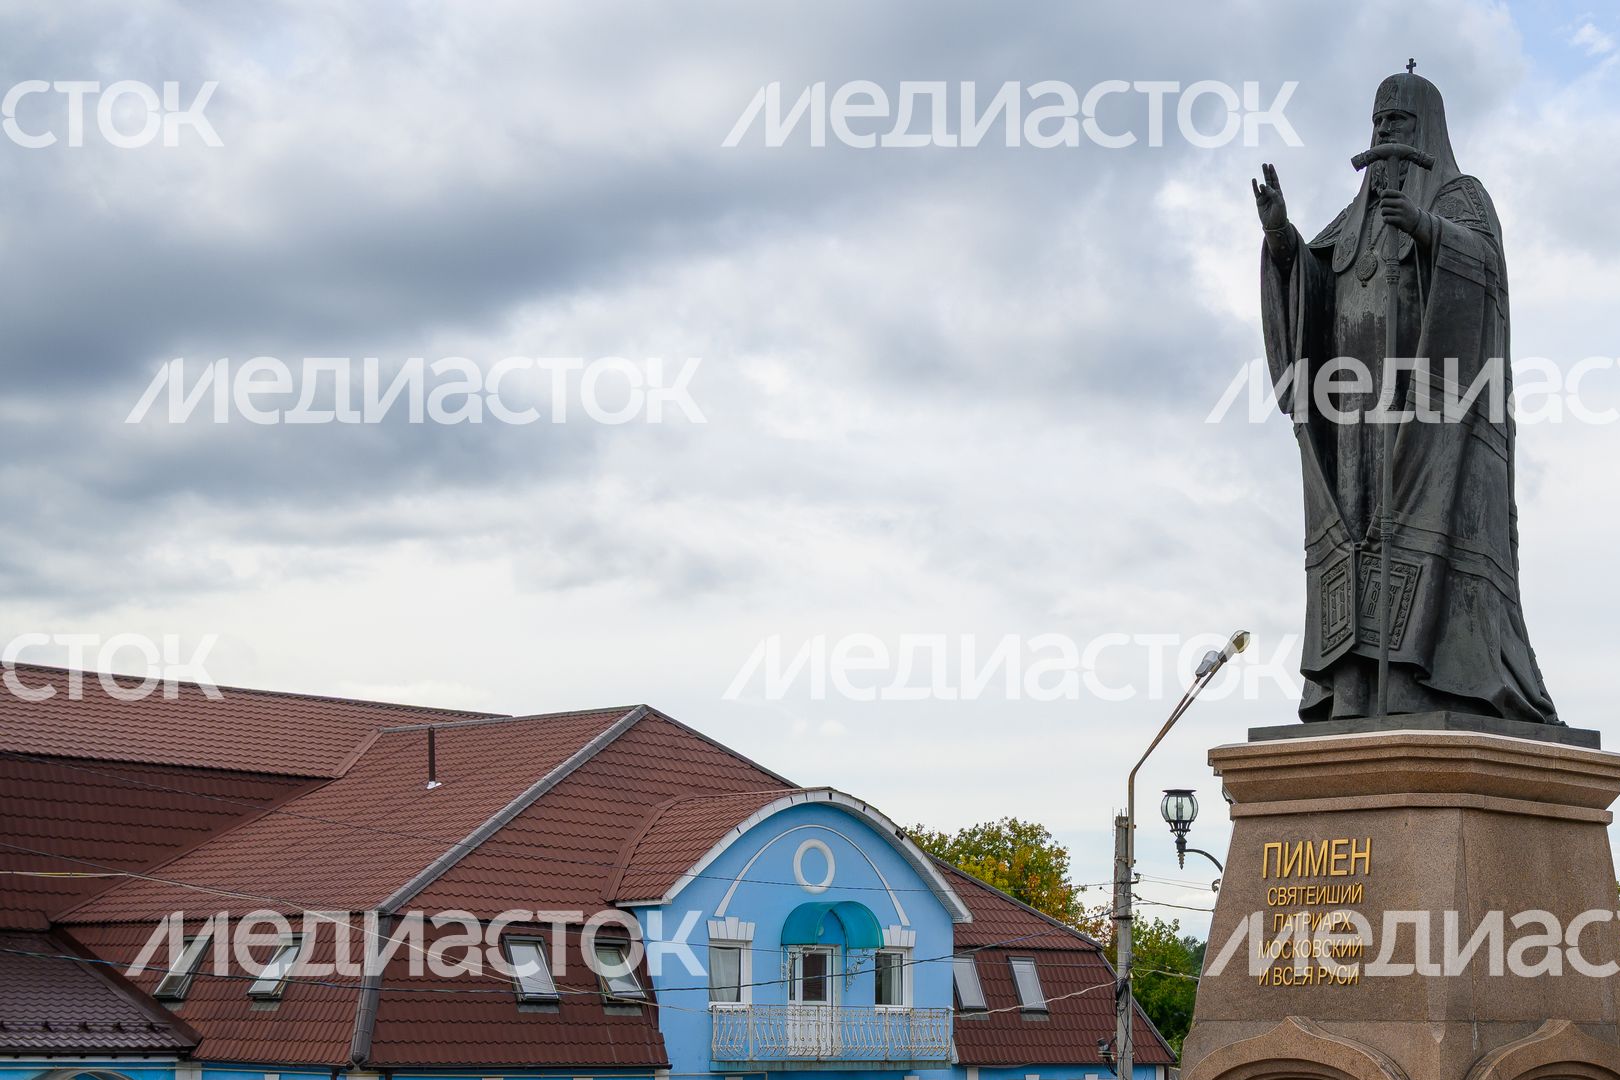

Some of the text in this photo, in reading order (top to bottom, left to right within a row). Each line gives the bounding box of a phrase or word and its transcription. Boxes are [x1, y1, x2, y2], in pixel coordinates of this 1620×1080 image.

[1261, 837, 1373, 879] ПИМЕН
[1273, 911, 1353, 932] ПАТРИАРХ
[1257, 935, 1364, 960] МОСКОВСКИЙ
[1257, 965, 1360, 986] И ВСЕЯ РУСИ
